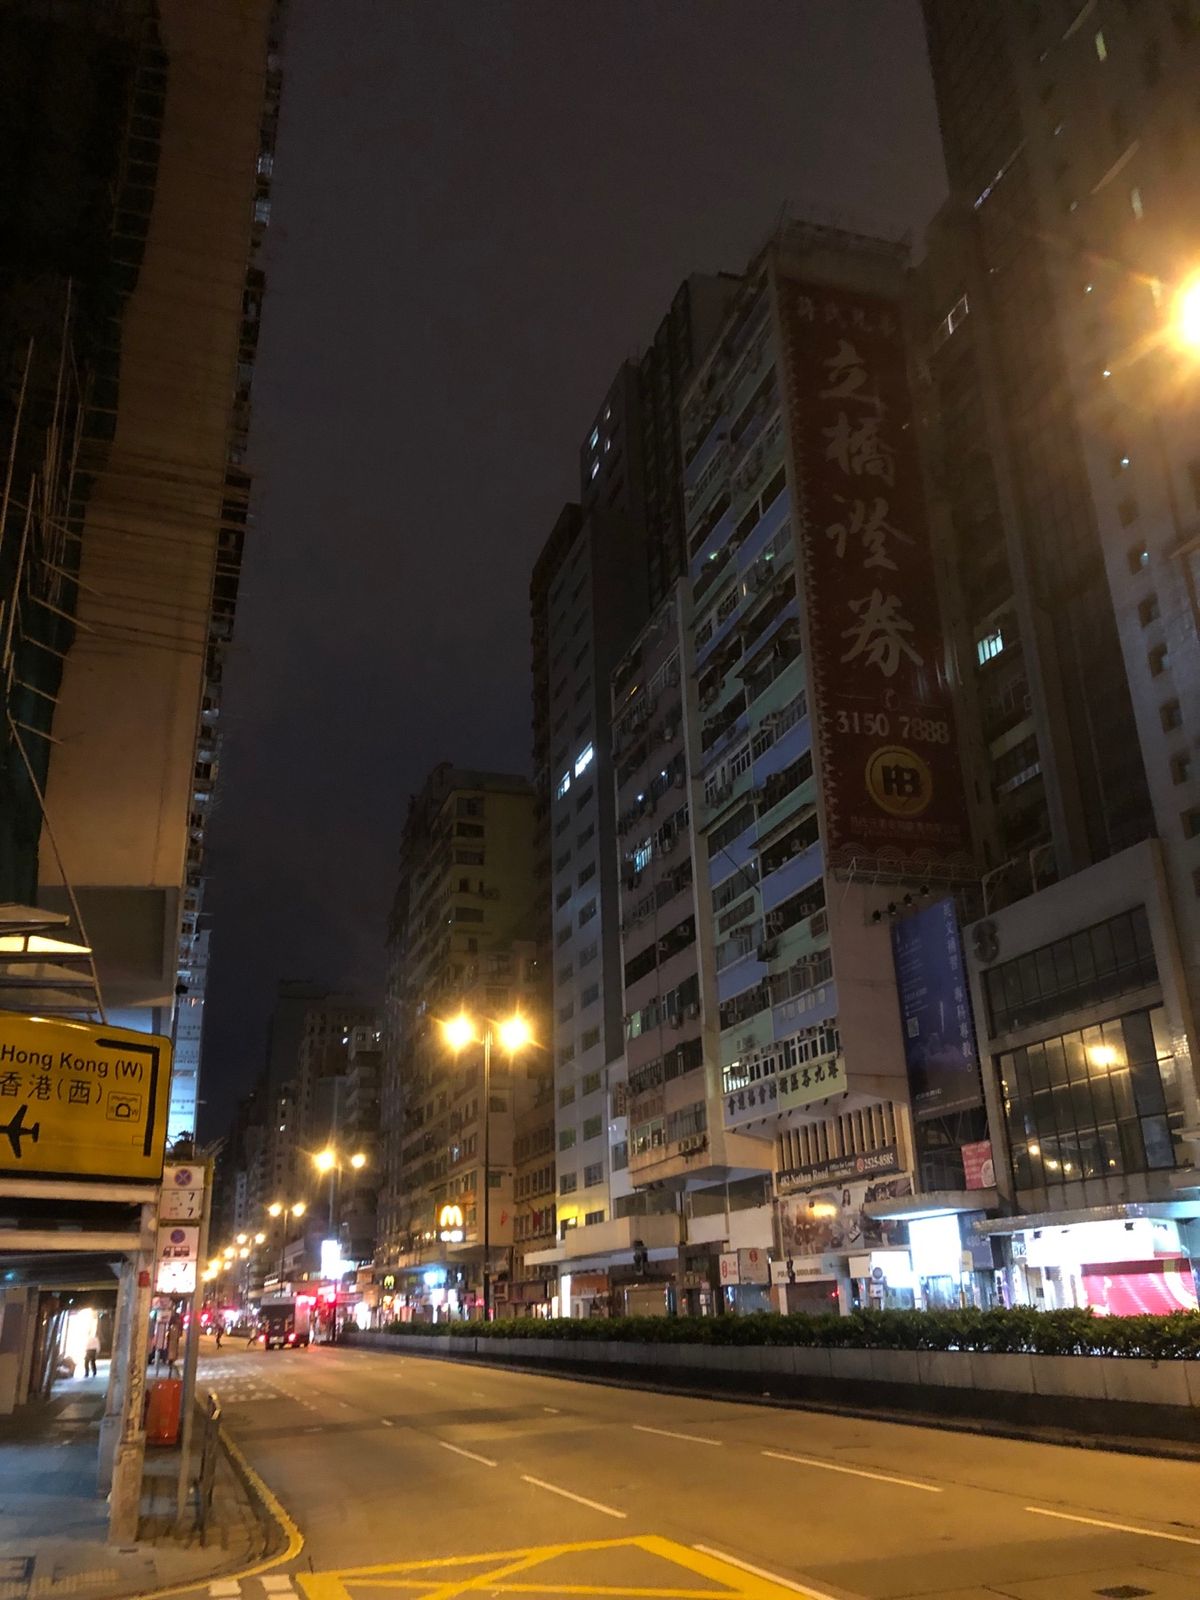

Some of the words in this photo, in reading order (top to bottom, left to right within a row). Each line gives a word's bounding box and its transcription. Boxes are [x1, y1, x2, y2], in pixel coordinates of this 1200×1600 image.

[836, 709, 890, 737] 3150
[1, 1044, 53, 1071] Hong
[60, 1052, 109, 1077] Kong
[115, 1060, 144, 1082] (W)
[0, 1071, 103, 1105] 香港(西)
[812, 1167, 829, 1180] Road
